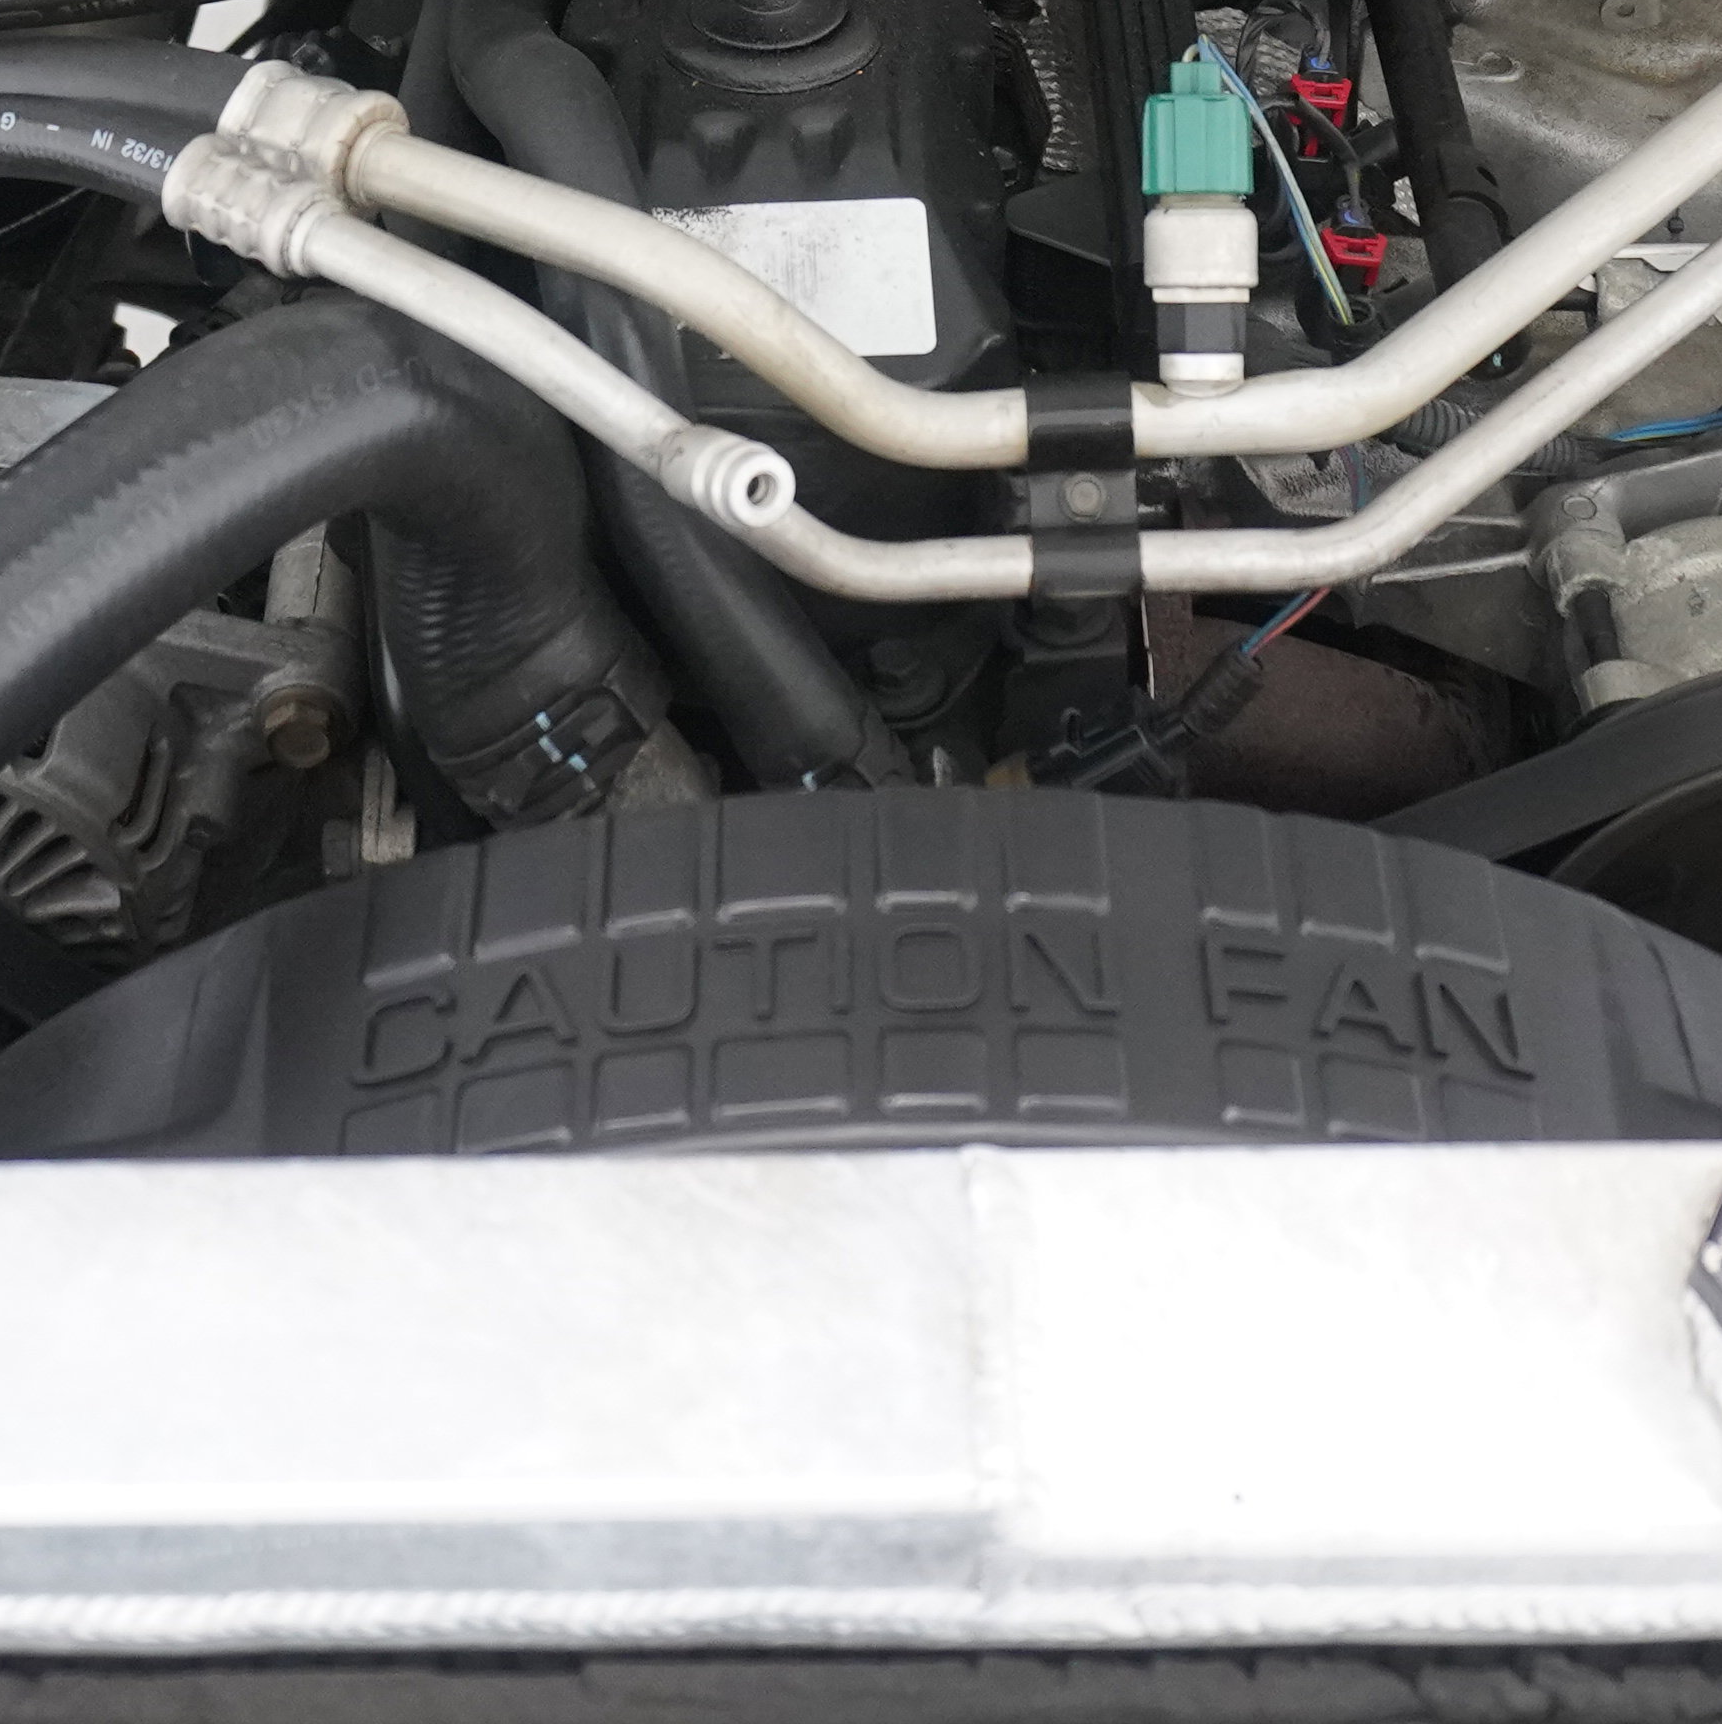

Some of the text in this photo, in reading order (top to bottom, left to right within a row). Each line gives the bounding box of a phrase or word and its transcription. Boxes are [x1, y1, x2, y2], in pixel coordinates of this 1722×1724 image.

[90, 128, 115, 152] IN
[121, 137, 174, 173] 13/32
[361, 922, 1535, 1082] CAUTION FAN
